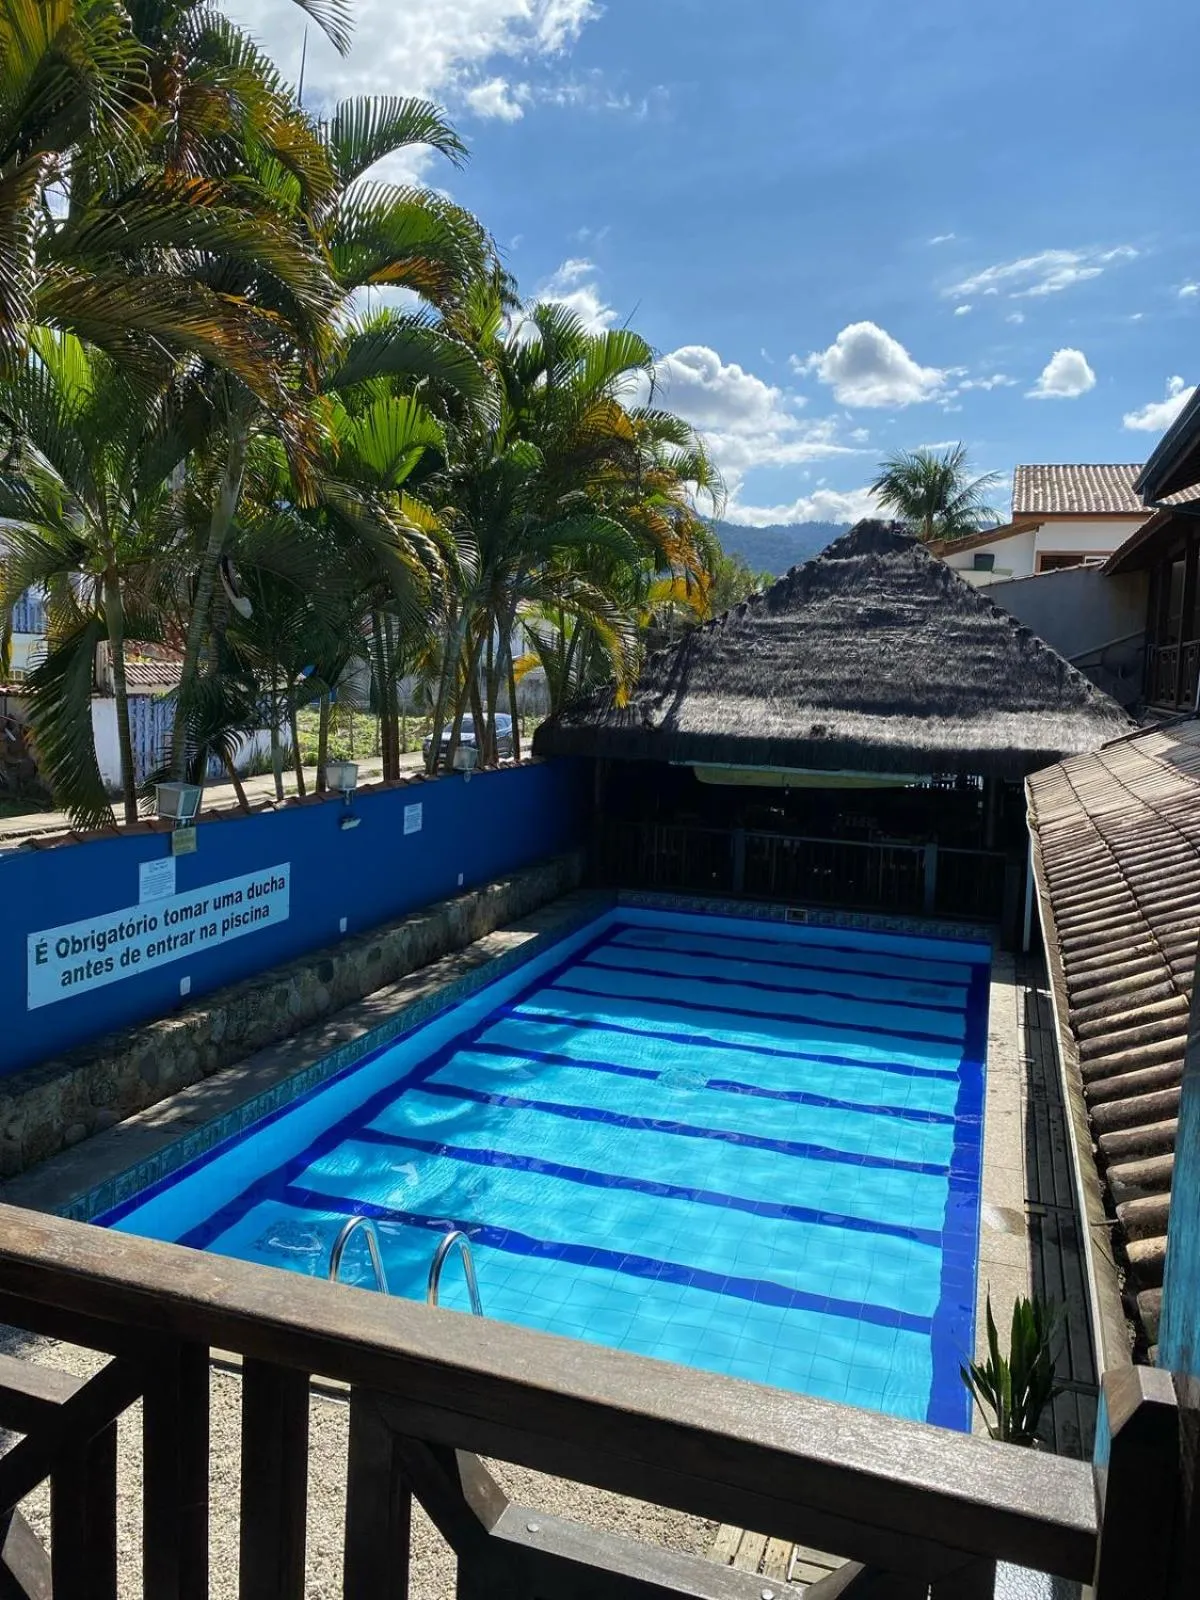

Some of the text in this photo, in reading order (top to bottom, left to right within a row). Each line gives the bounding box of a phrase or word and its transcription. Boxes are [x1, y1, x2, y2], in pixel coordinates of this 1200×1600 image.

[34, 875, 285, 966] É Obrigatório tomar uma ducha
[60, 903, 270, 987] antes de entrar na piscina
